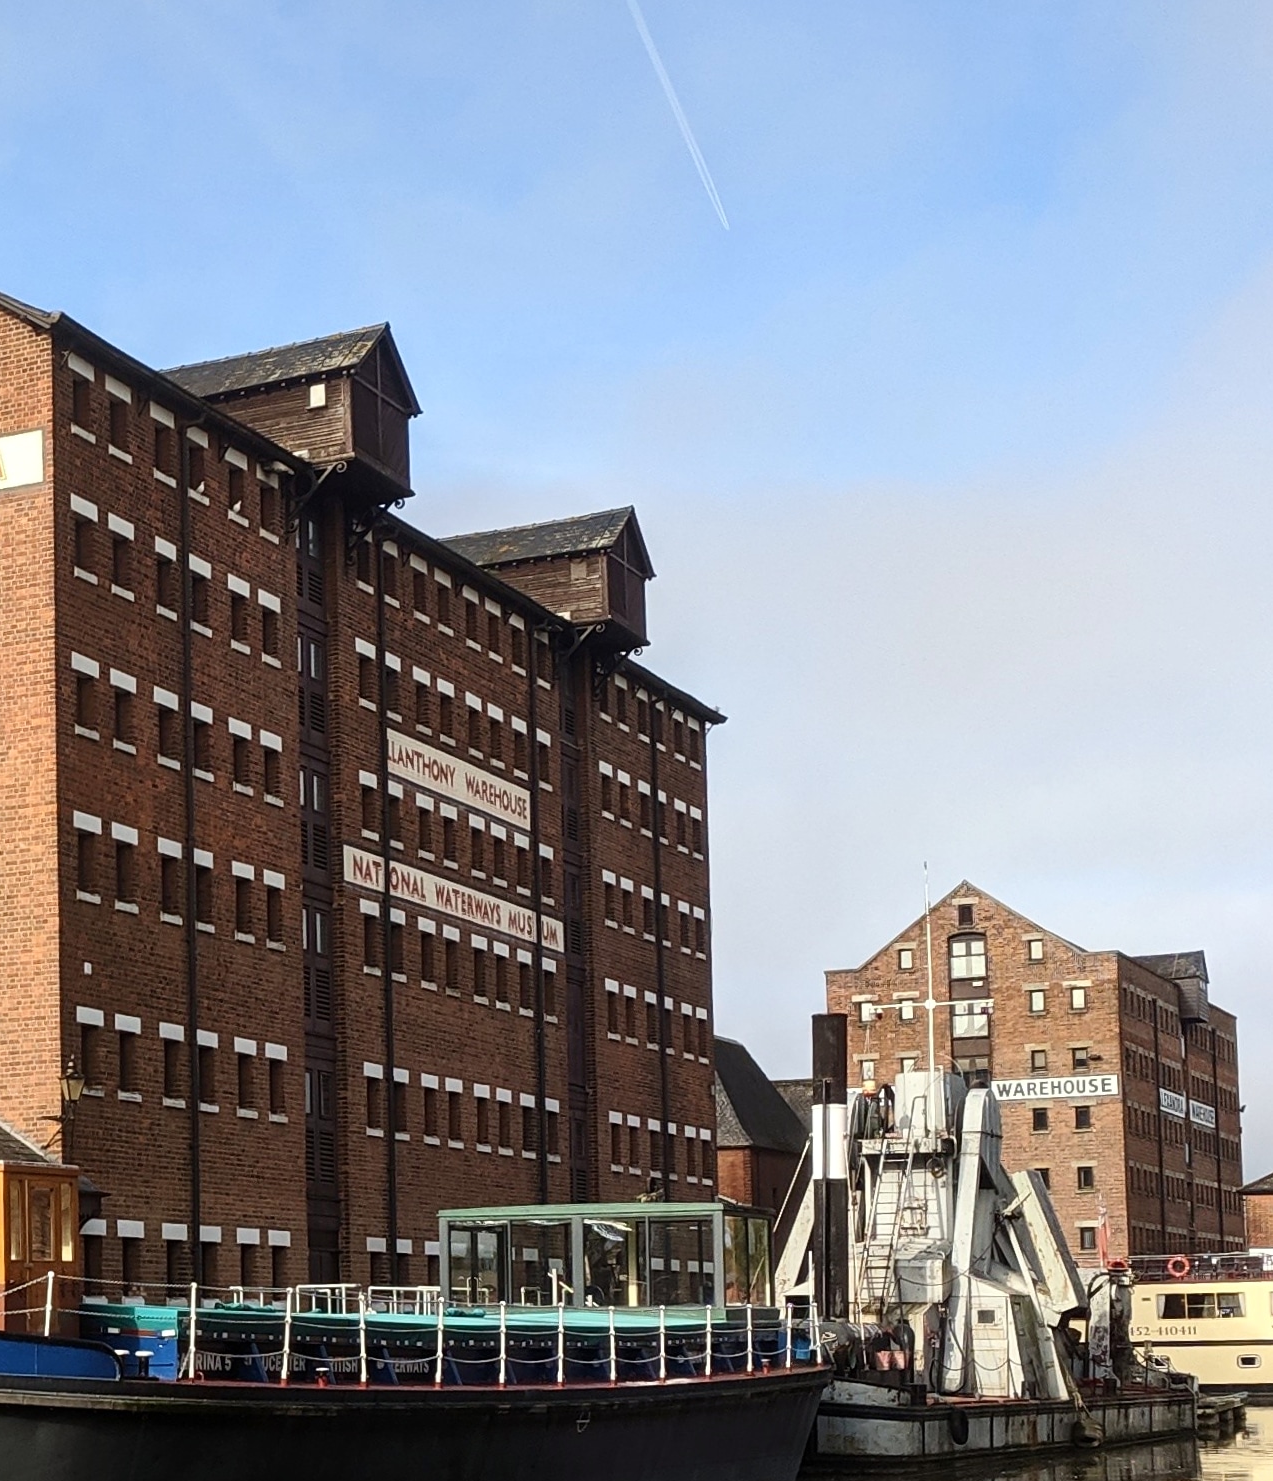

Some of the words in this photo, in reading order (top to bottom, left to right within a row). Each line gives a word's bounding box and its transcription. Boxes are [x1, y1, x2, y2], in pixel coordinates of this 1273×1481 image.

[387, 740, 456, 788] LANTHONY
[464, 771, 528, 820] WAREHOUSE
[352, 853, 427, 902] NATONAL
[434, 882, 502, 927] WATERWAYS
[508, 909, 559, 948] MUSUM
[996, 1077, 1113, 1098] WAREHOUSE
[224, 1357, 231, 1371] 5
